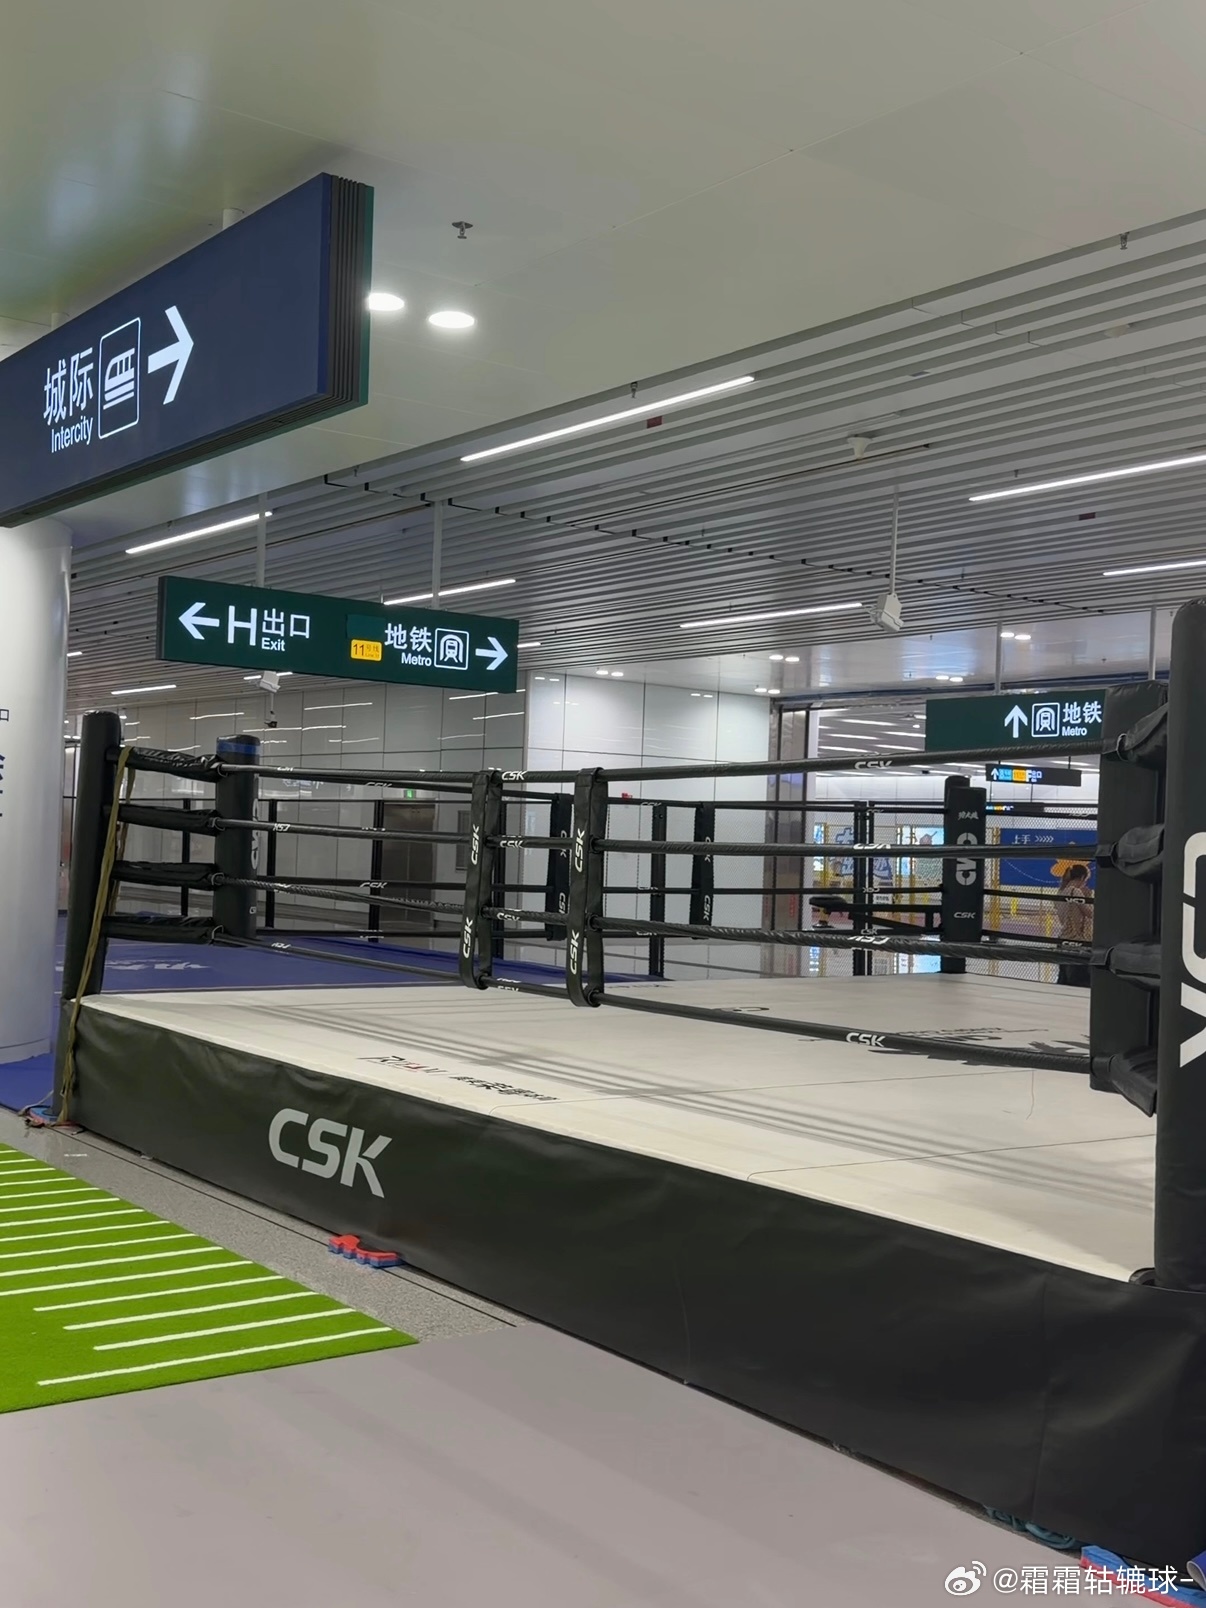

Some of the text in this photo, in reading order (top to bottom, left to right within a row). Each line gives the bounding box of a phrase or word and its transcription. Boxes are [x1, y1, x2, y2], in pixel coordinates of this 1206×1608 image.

[43, 346, 94, 426] 城际
[51, 415, 94, 453] Intercity
[227, 604, 257, 647] H
[262, 607, 310, 639] 出口
[384, 622, 432, 653] 地铁
[261, 636, 286, 652] Exit
[401, 652, 432, 667] Metro
[1062, 700, 1103, 725] 地铁
[1061, 726, 1088, 737] Metro
[501, 770, 527, 780] CSK
[470, 823, 480, 866] CSK
[574, 828, 586, 873] CSK
[953, 911, 977, 919] CSK
[462, 916, 474, 959] CSK
[569, 929, 581, 975] CSK
[845, 1031, 886, 1048] CSK
[268, 1107, 393, 1198] CSK
